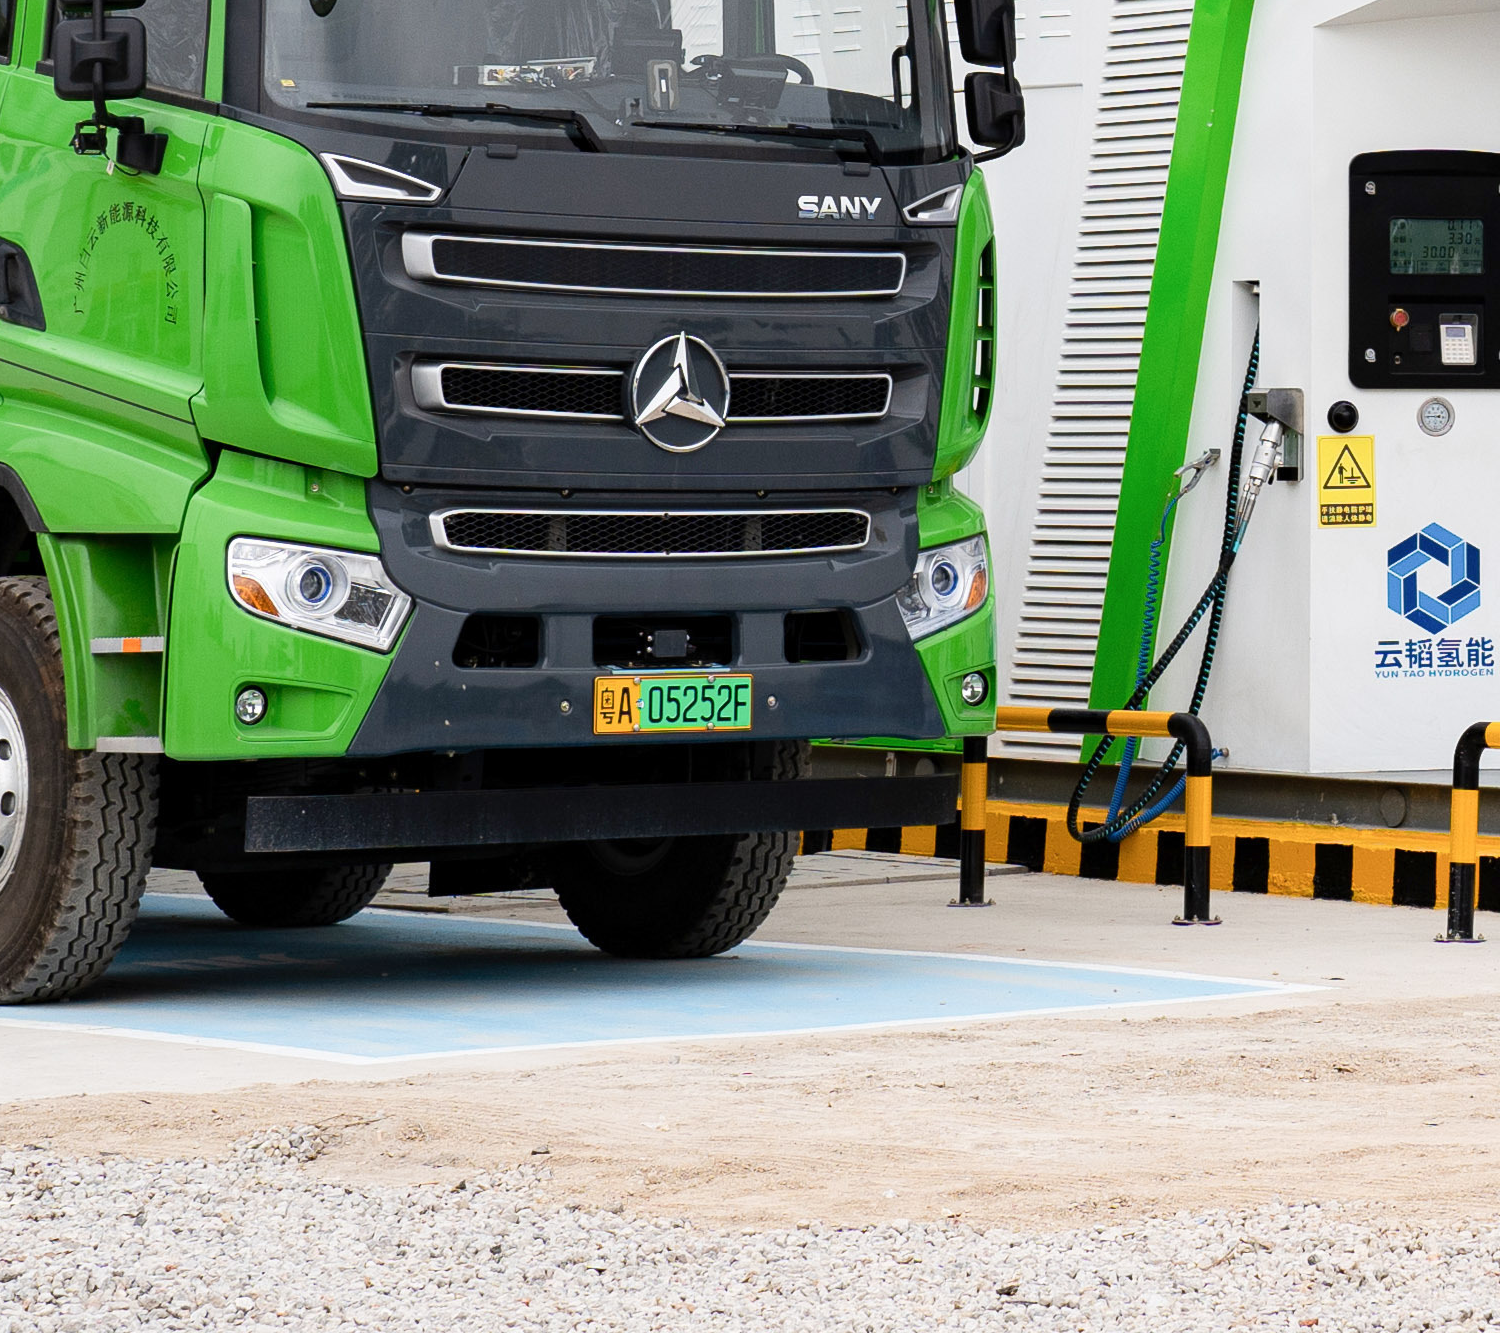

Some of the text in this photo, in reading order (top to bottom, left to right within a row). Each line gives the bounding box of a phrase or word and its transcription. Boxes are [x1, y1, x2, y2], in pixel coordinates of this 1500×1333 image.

[798, 196, 882, 220] SANY
[73, 201, 179, 325] 广州白云新能源科技有限公司
[1374, 636, 1495, 669] 云韬氢能
[1375, 668, 1494, 679] YUN TAO HYDROGEN
